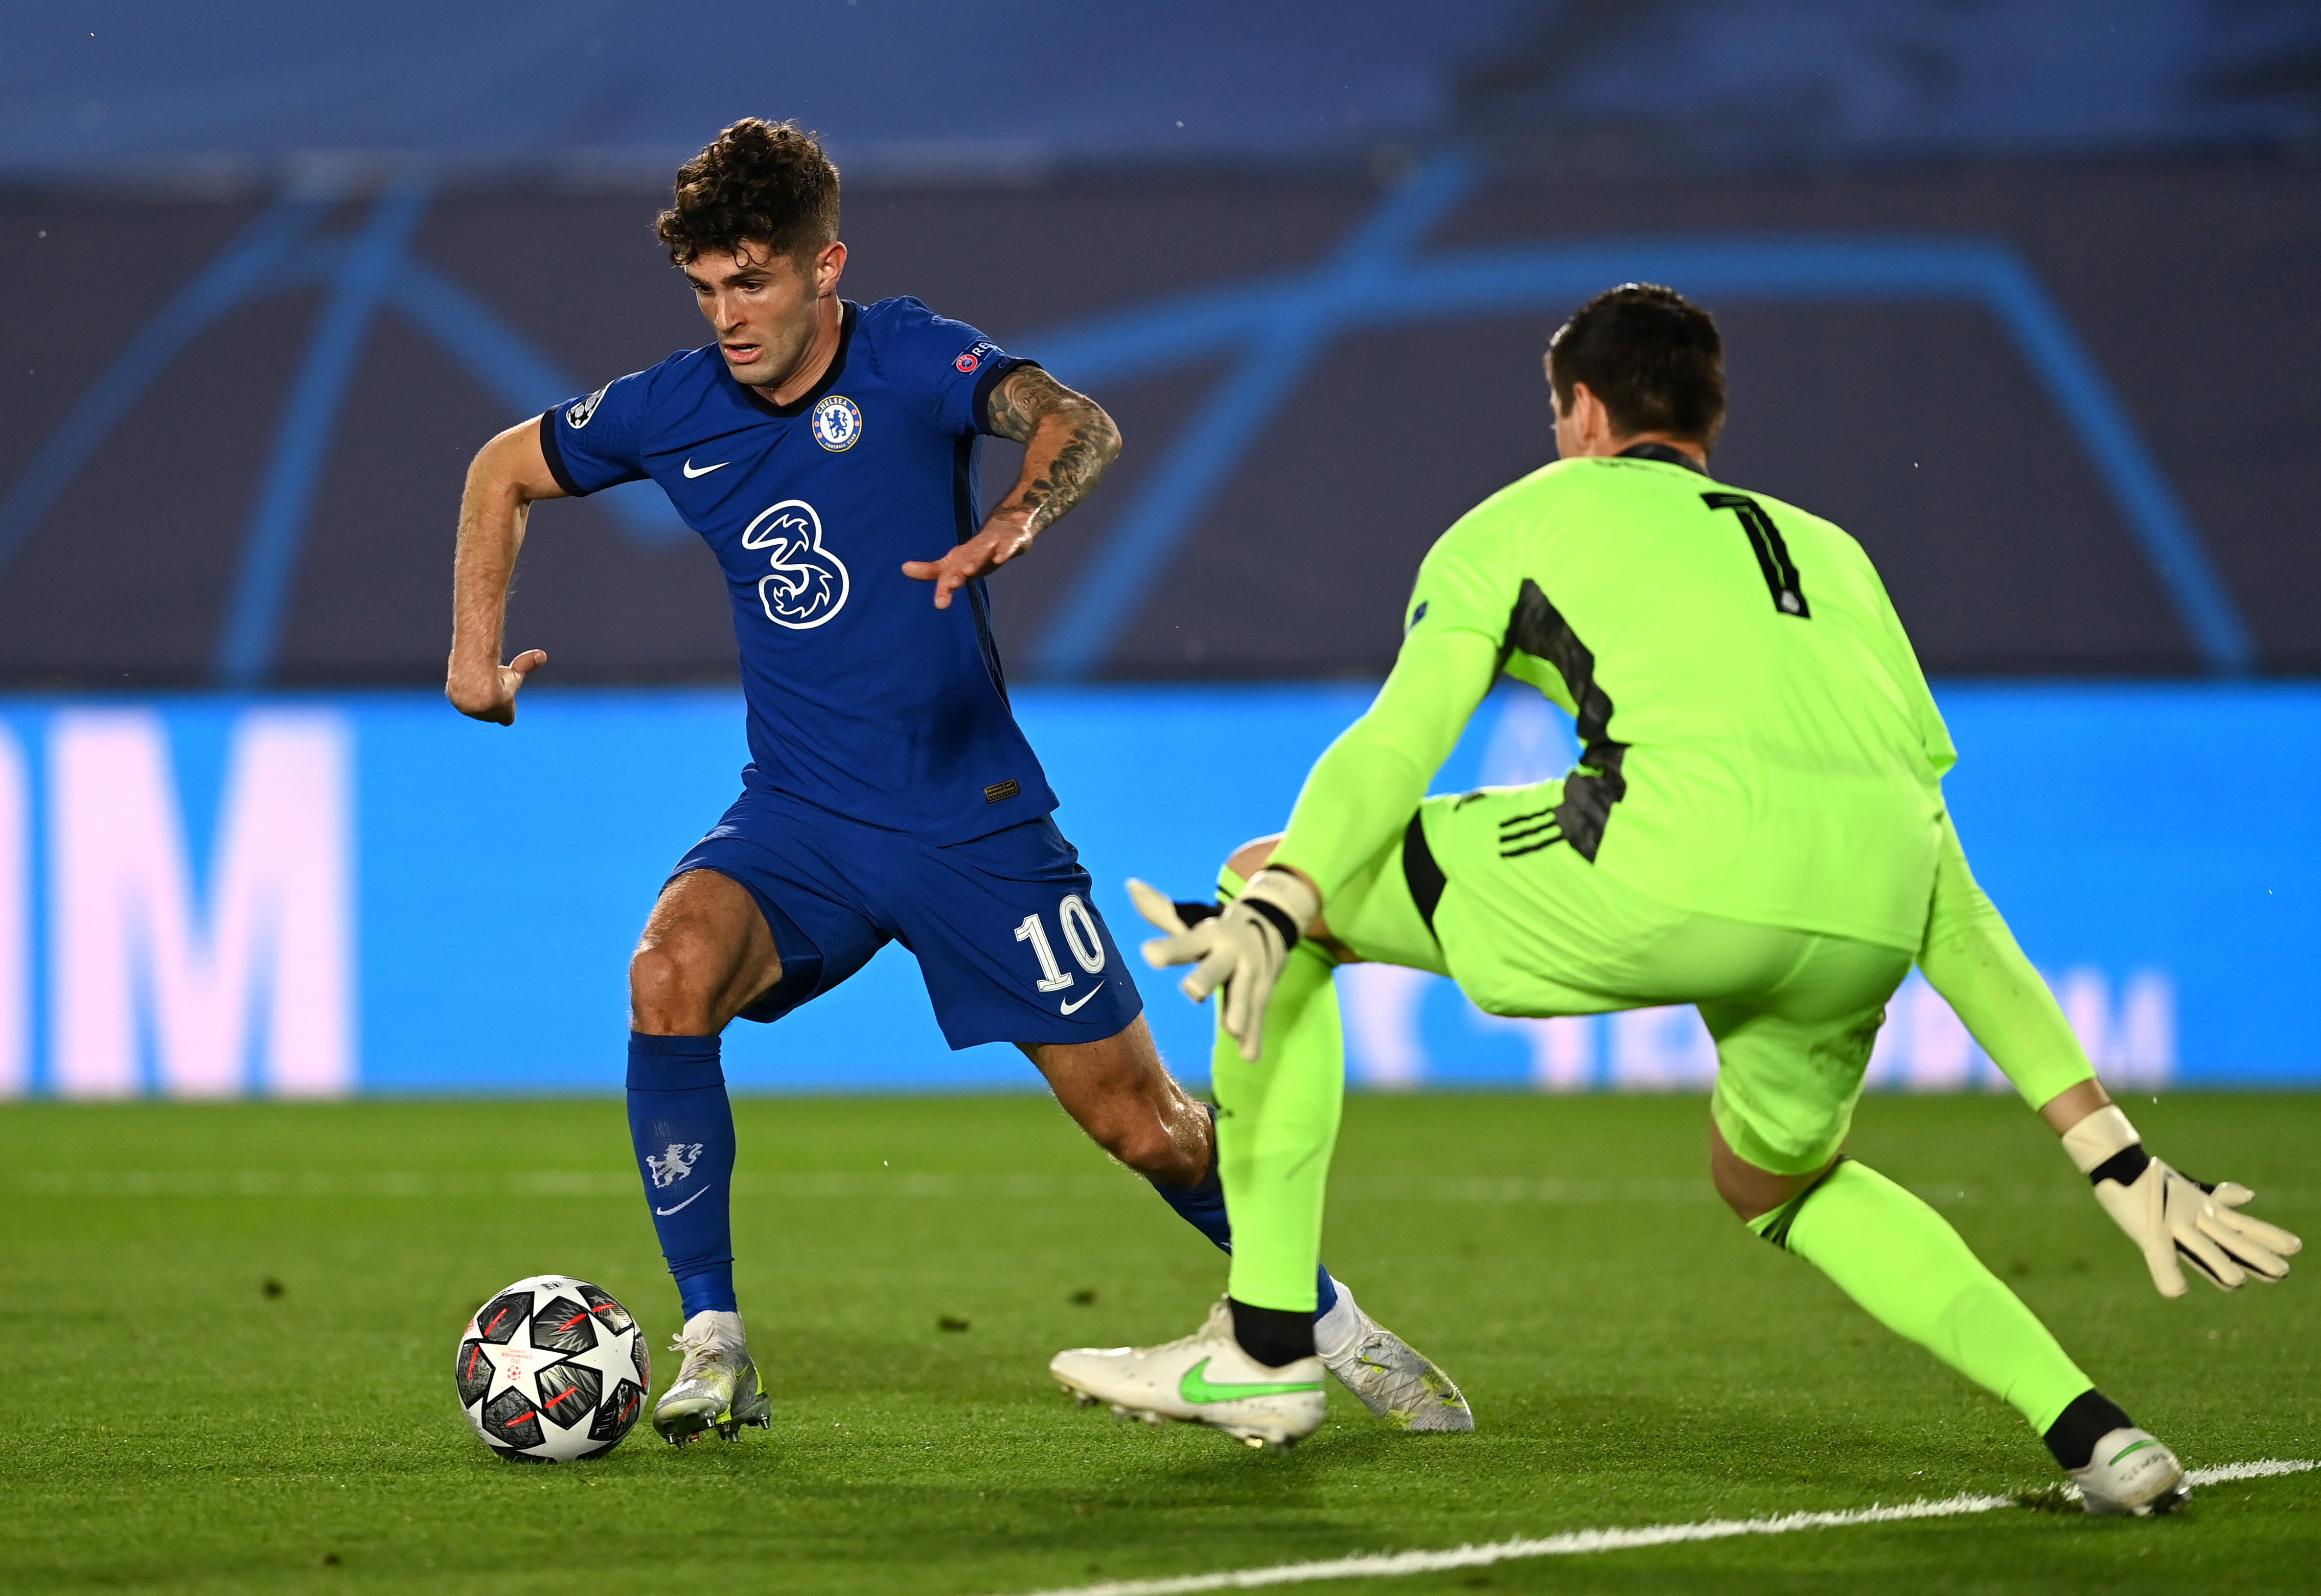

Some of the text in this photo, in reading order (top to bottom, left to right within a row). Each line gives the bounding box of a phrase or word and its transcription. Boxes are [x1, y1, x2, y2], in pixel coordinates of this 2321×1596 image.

[817, 398, 847, 414] CHELSEA
[846, 433, 857, 445] CLUB
[742, 499, 849, 630] 3
[0, 708, 359, 1098] M
[1014, 894, 1106, 993] 10
[501, 1352, 533, 1360] CHAMPIONS
